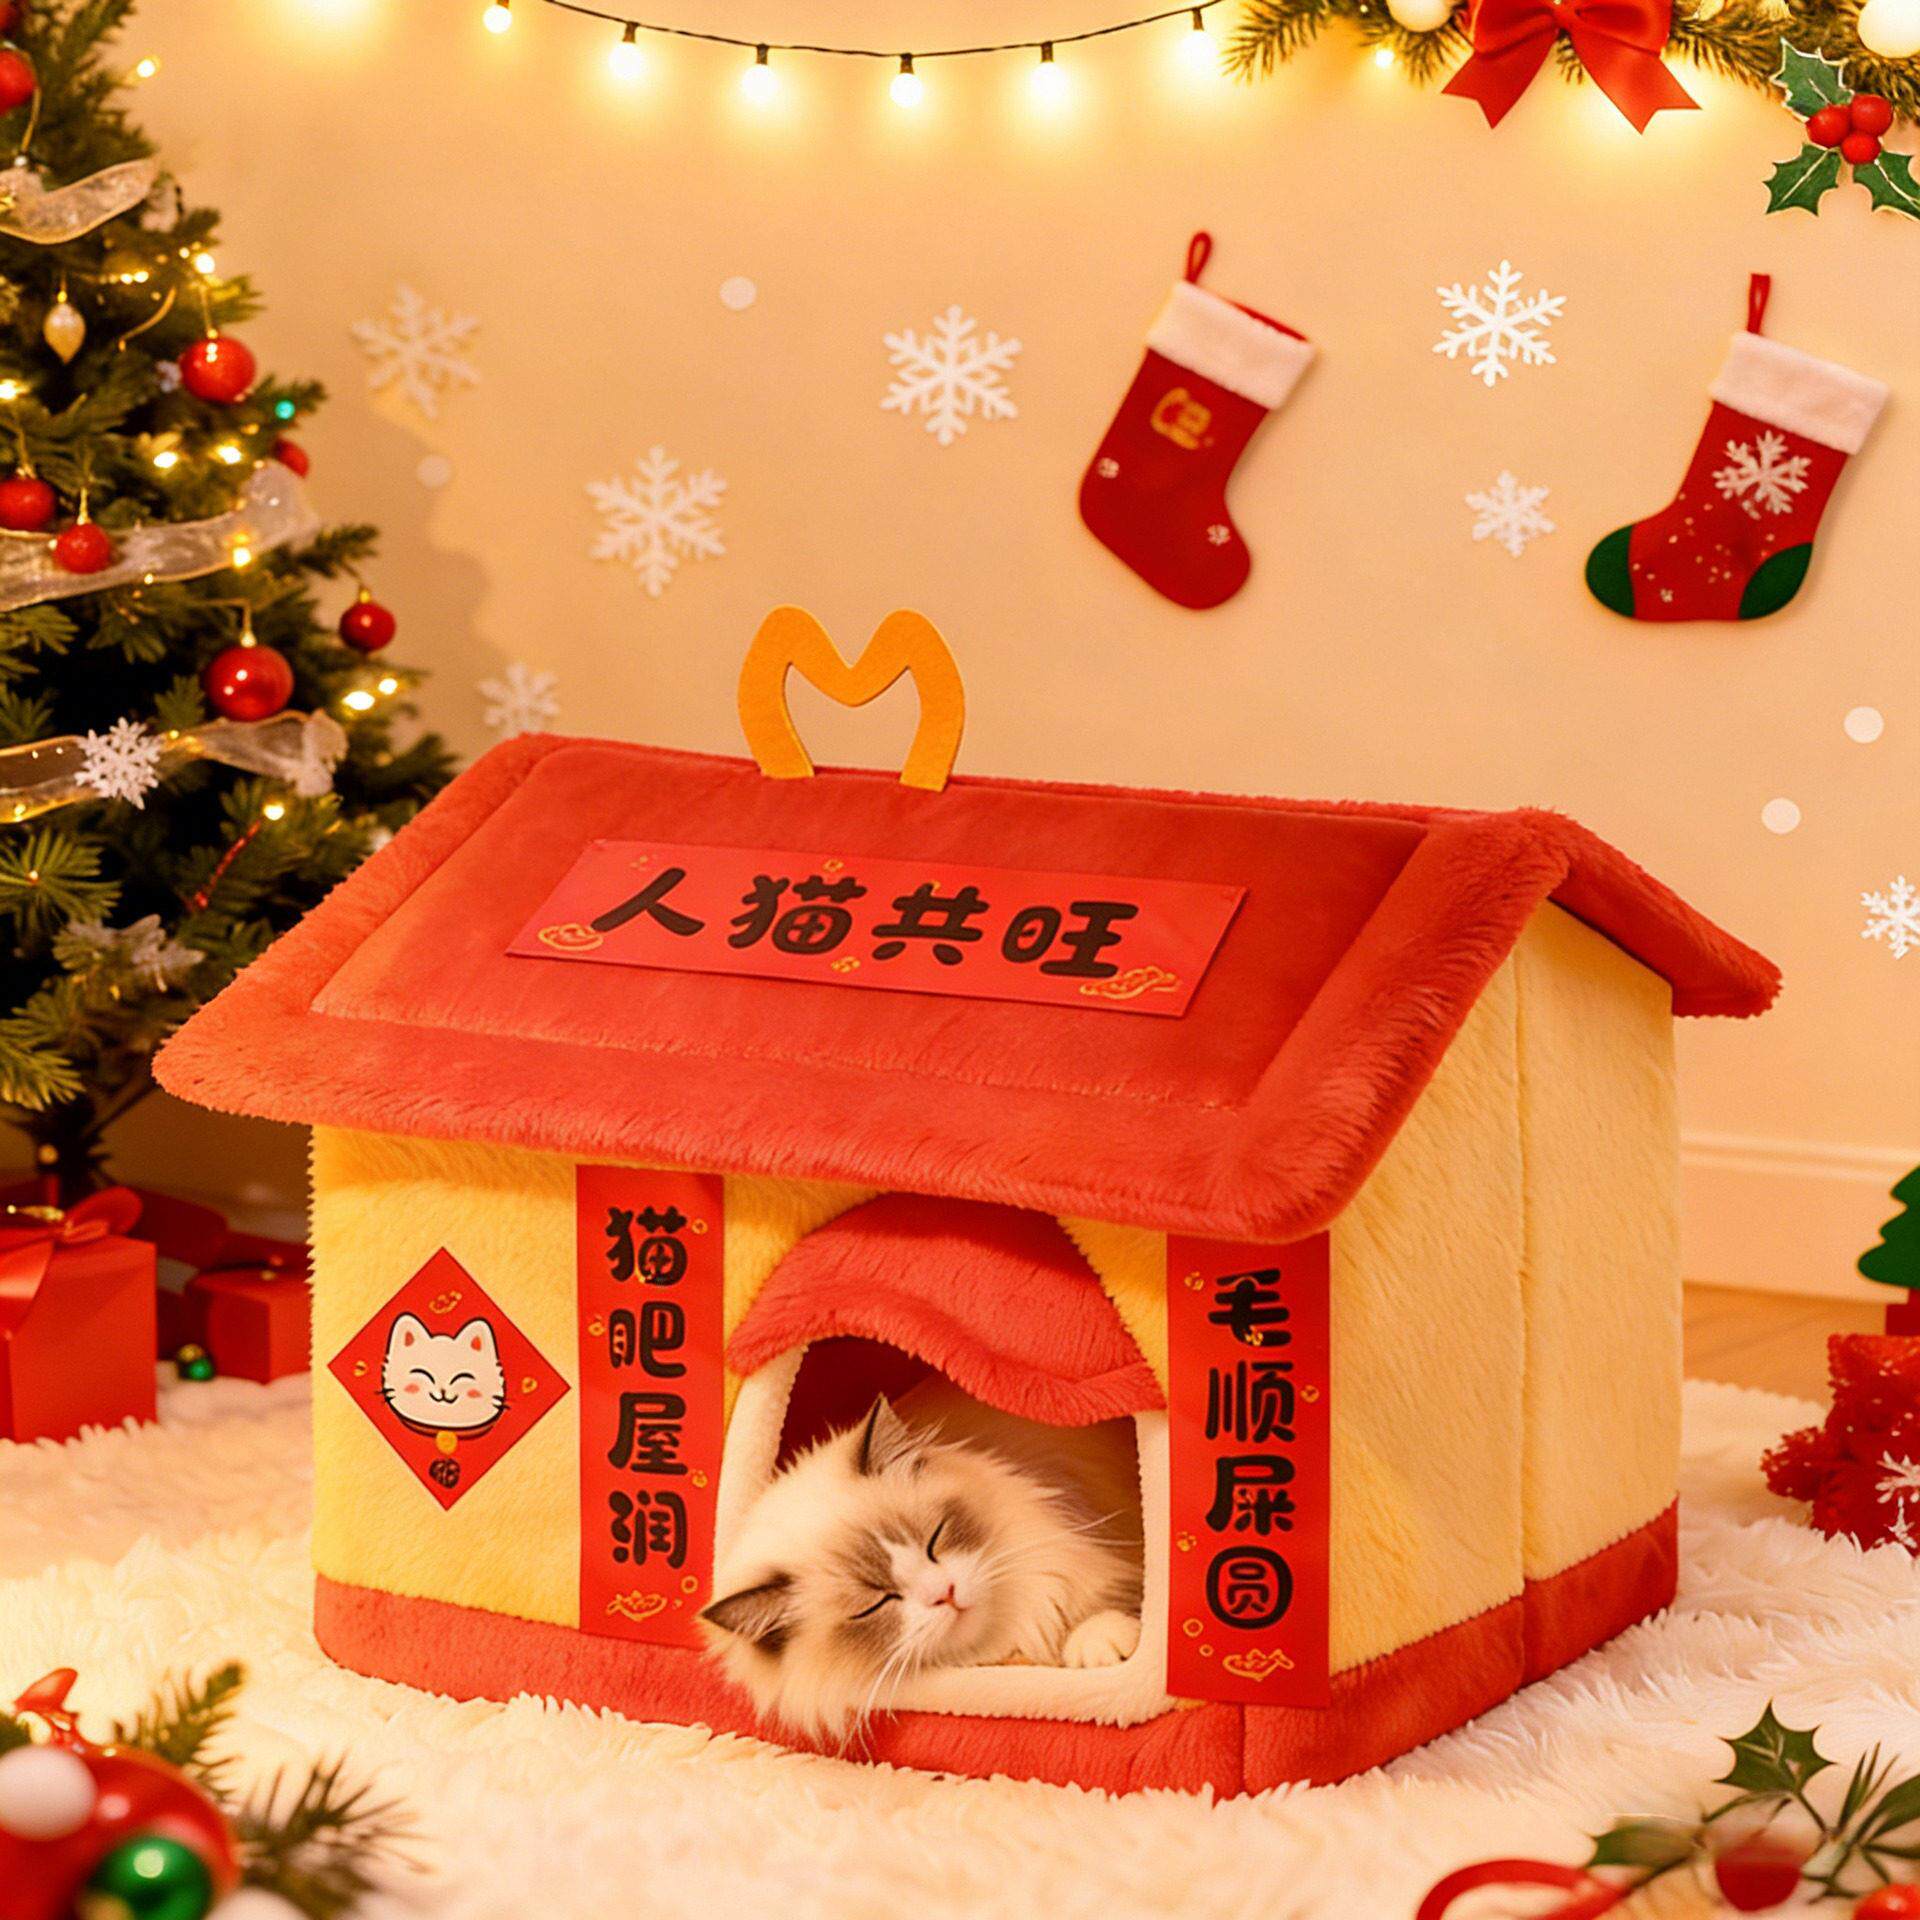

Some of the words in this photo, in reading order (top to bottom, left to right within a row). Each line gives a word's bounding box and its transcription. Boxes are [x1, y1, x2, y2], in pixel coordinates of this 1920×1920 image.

[591, 867, 1139, 978] 人猫共旺
[605, 1206, 688, 1569] 猫肥屋润
[1205, 1268, 1296, 1630] 毛顺屎圆
